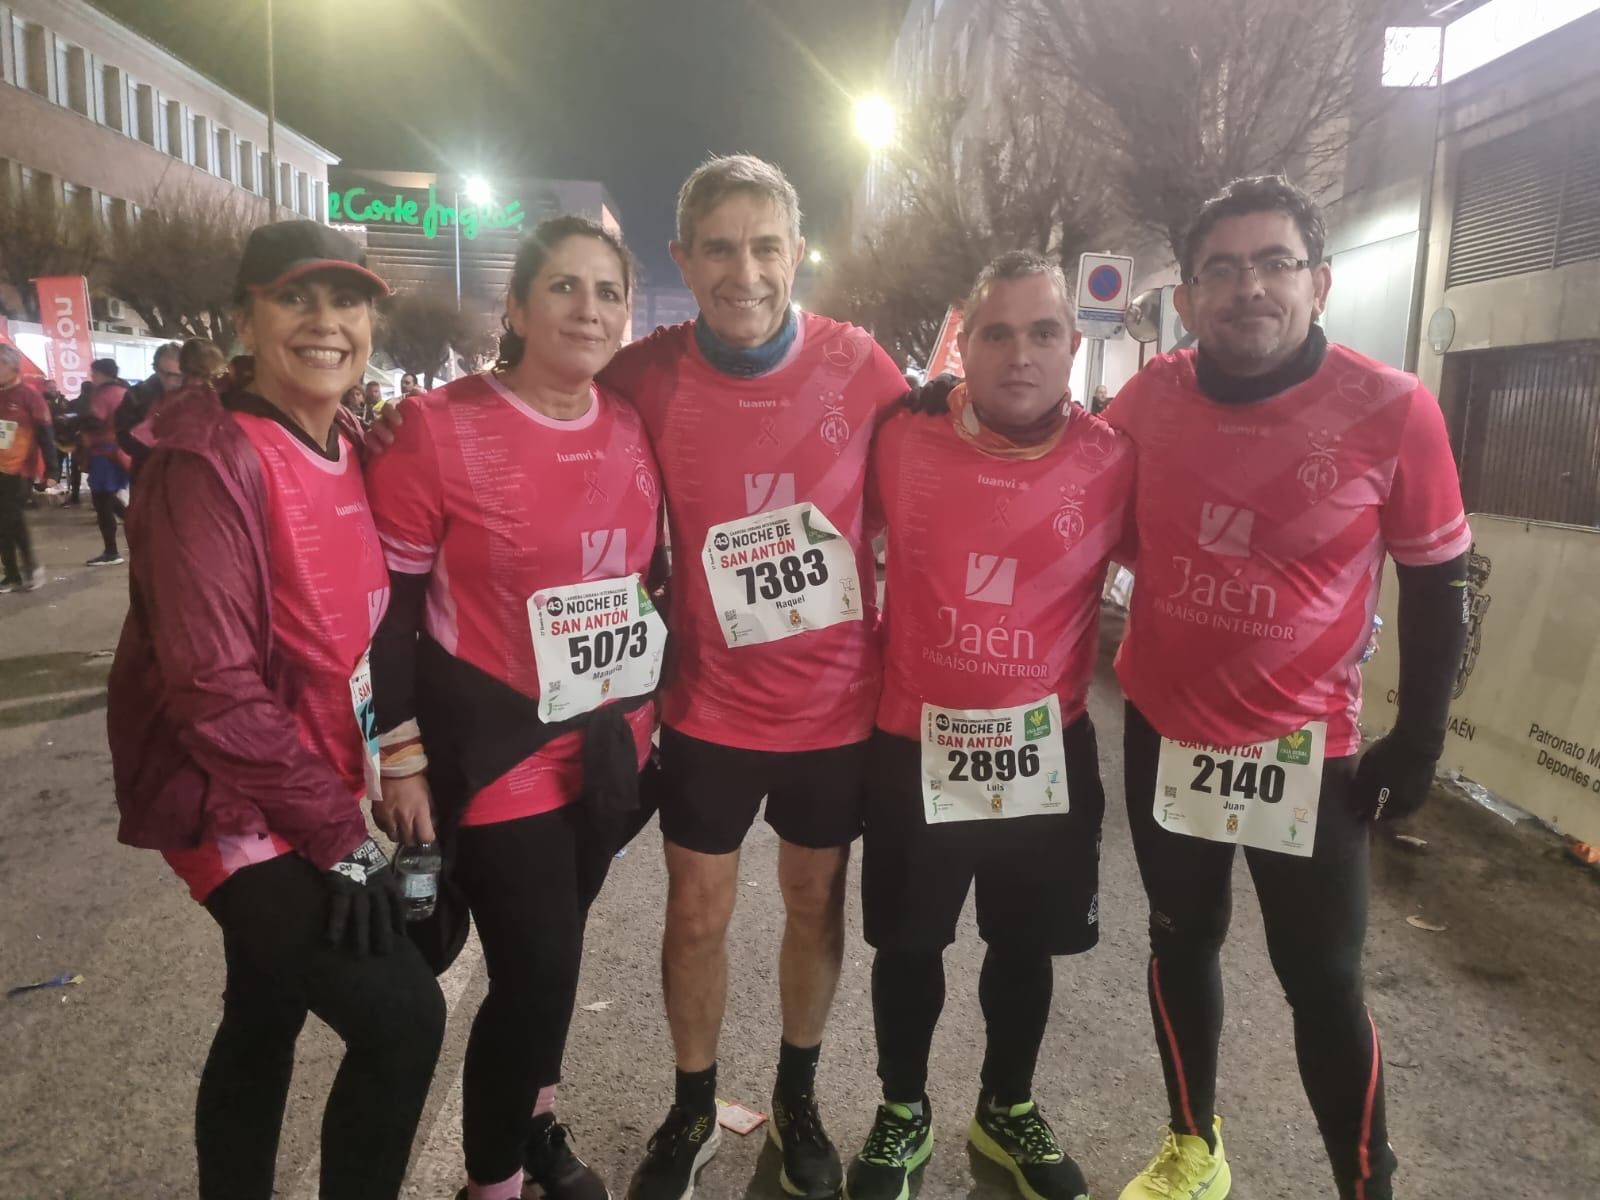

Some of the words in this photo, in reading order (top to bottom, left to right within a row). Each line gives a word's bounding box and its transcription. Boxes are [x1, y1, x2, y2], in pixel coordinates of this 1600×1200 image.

[343, 187, 419, 225] Corte
[739, 399, 777, 408] luanvi
[557, 449, 593, 463] luanvi
[978, 474, 1016, 488] luanvi
[732, 527, 774, 549] NOCHE
[776, 523, 791, 538] DE
[720, 550, 748, 569] SAN
[751, 537, 796, 562] ANTÓN
[736, 548, 829, 605] 7383
[1168, 556, 1277, 618] Jaén
[567, 599, 611, 615] NOCHE
[613, 593, 629, 607] DE
[776, 595, 806, 610] Raquel
[551, 620, 581, 636] SAN
[585, 608, 629, 631] ANTÓN
[936, 606, 1035, 660] Jaén
[1212, 613, 1294, 641] INTERIOR
[568, 621, 648, 675] 5073
[982, 661, 1048, 678] INTERIOR
[937, 734, 964, 748] SAN
[967, 733, 1013, 748] ANTÓN
[952, 722, 994, 734] NOCHE
[997, 721, 1013, 734] DE
[1529, 723, 1585, 761] Patronato
[948, 744, 1040, 782] 2896
[1537, 750, 1590, 788] Deportes
[986, 783, 1005, 792] Luis
[1190, 754, 1286, 803] 2140
[1223, 801, 1245, 811] Juan
